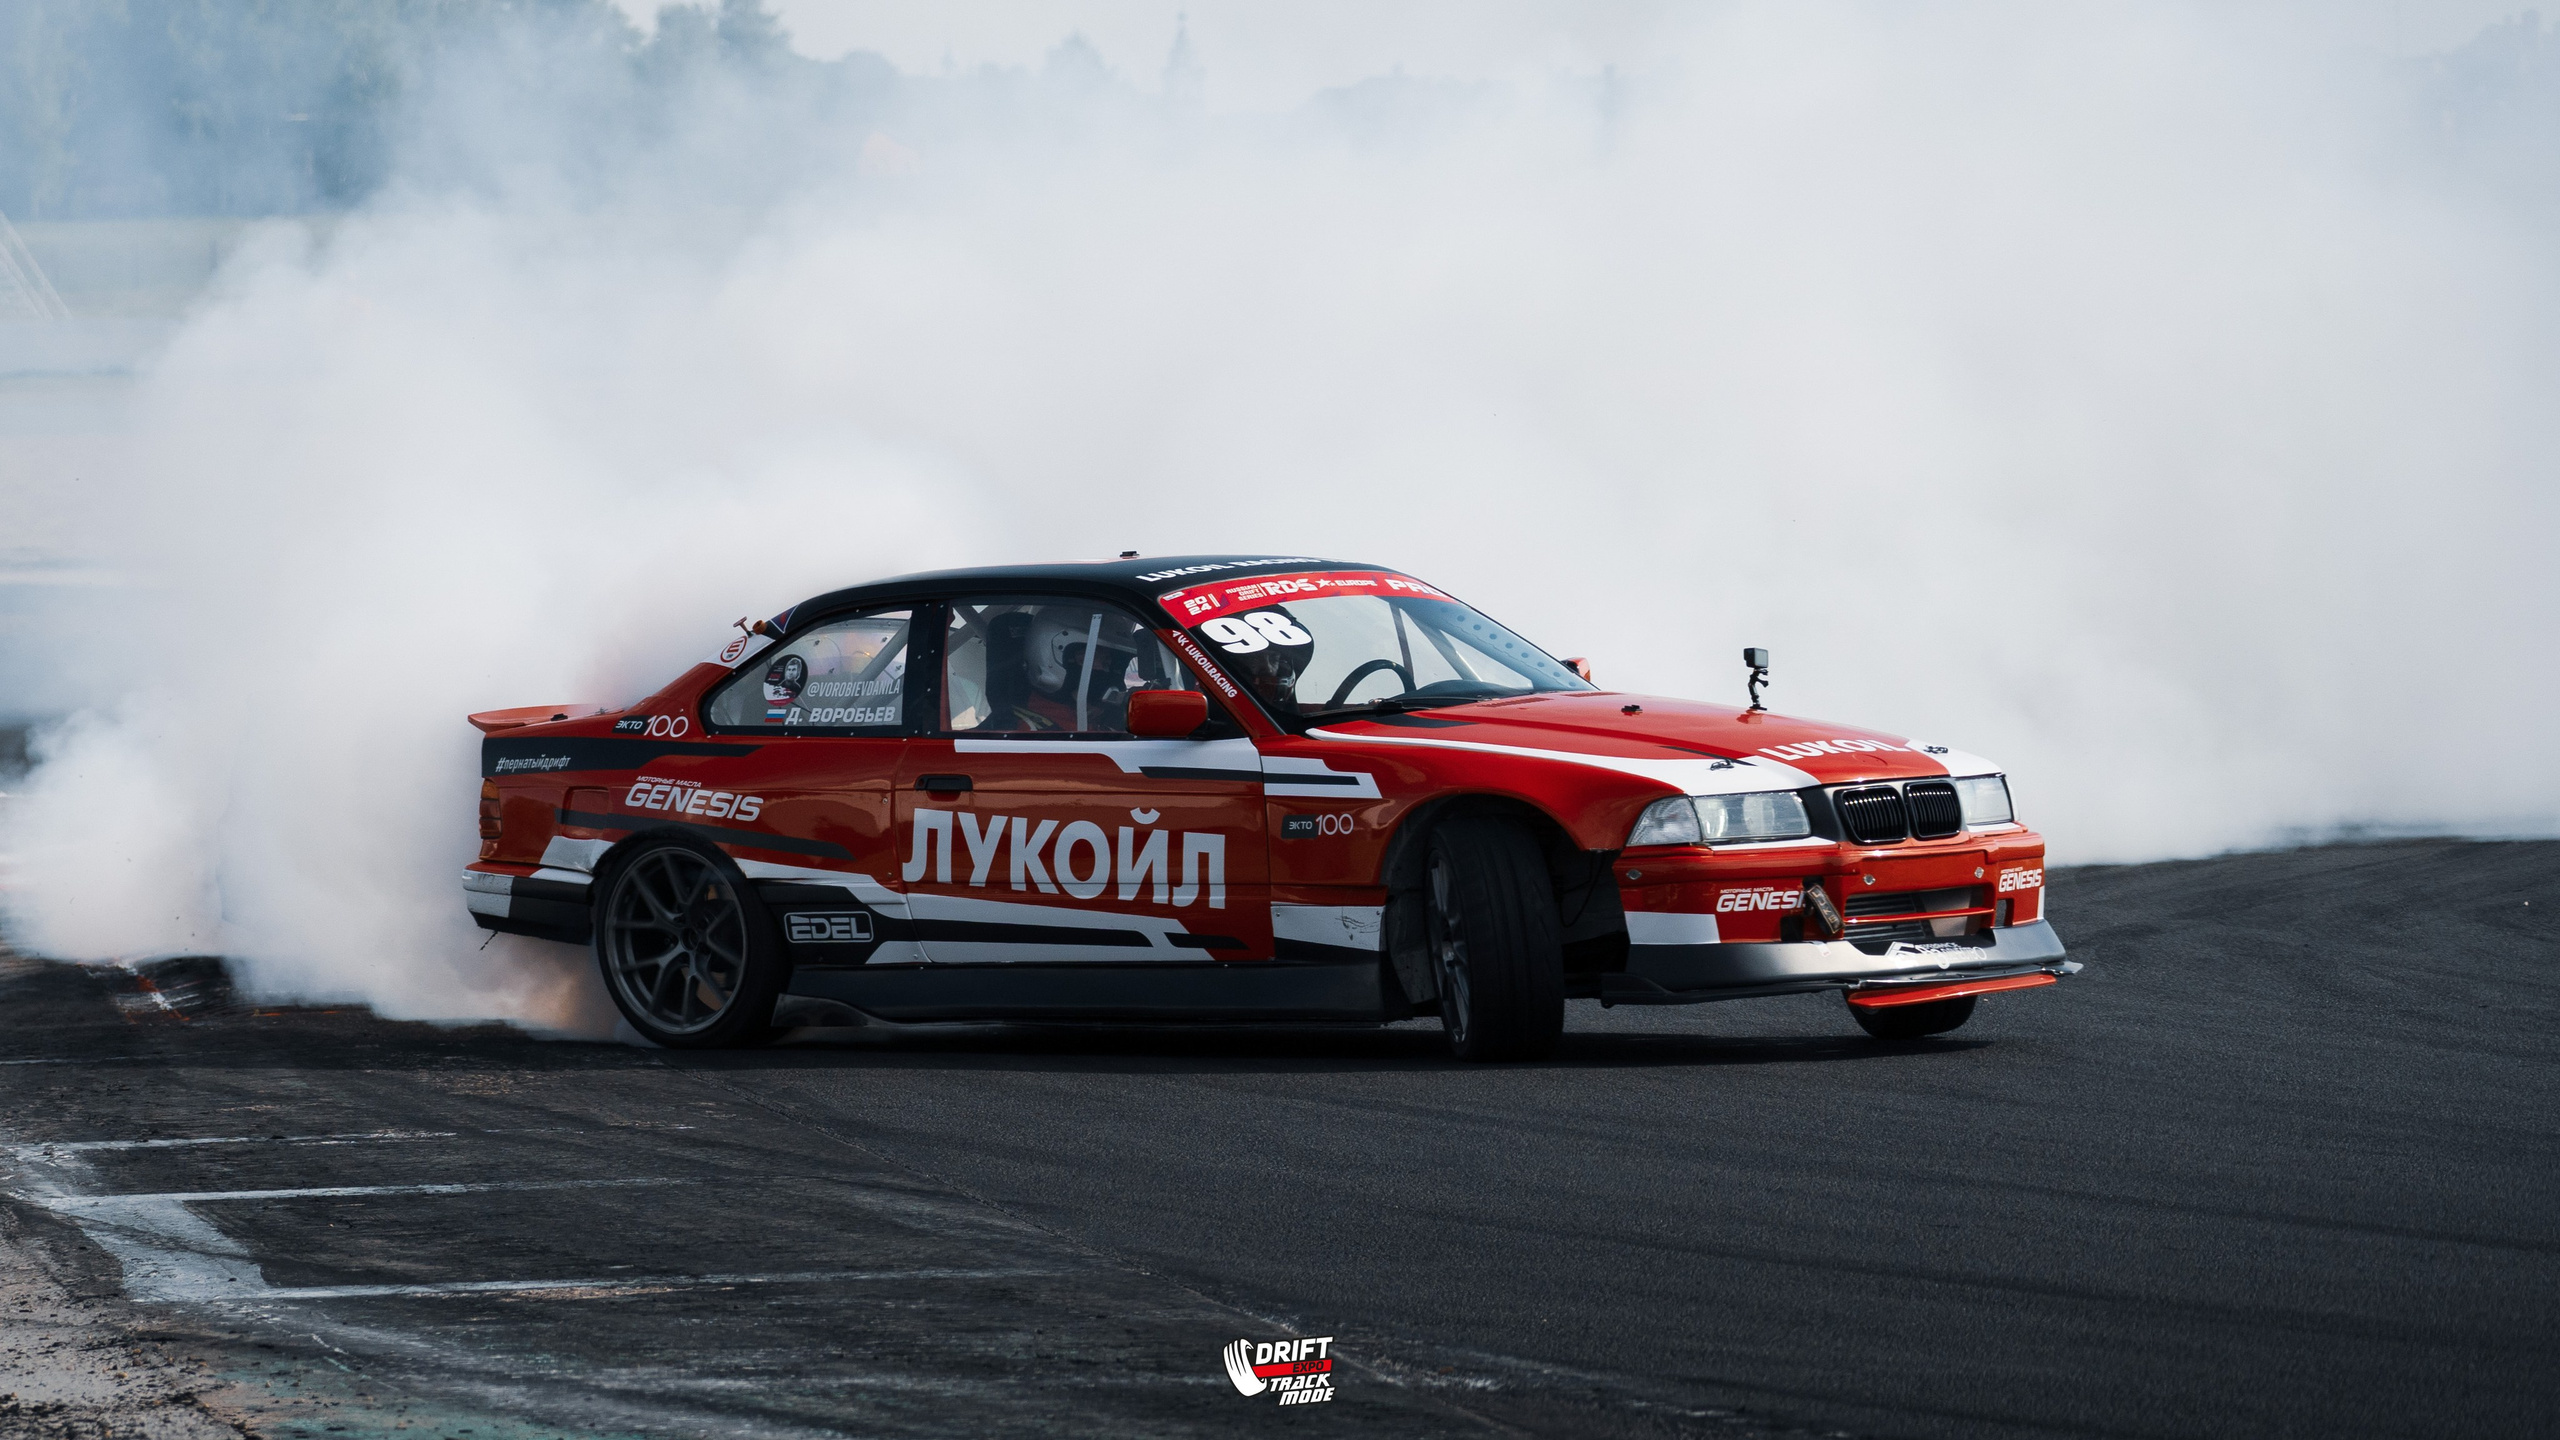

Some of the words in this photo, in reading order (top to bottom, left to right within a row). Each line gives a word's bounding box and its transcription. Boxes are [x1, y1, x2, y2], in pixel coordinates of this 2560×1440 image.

[1135, 564, 1235, 582] LUKOIL
[1225, 584, 1258, 594] RUSSIAN
[1238, 593, 1264, 602] SERIES
[1239, 588, 1260, 596] DRIFT
[1261, 578, 1318, 596] RDS
[1334, 579, 1378, 587] EUROPE
[1201, 611, 1312, 653] 98
[1185, 644, 1238, 698] LUKOILRACING
[807, 679, 901, 697] @VOROBIEVDANILA
[615, 720, 643, 730] ЭКТО
[643, 714, 689, 738] 100
[784, 707, 802, 725] Д.
[809, 706, 896, 723] ВОРОБЬЕВ
[1757, 739, 1912, 761] LUKOIL
[495, 754, 571, 773] #пернатыйдрифт
[636, 775, 676, 786] МОТОРНЫЕ
[676, 779, 702, 788] МАСЛА
[625, 782, 764, 822] GENESIS
[1288, 820, 1313, 830] ЭКТО
[1315, 813, 1354, 836] 100
[902, 807, 1226, 910] ЛУКОЙЛ
[1998, 868, 2043, 892] GENESIS
[1716, 890, 1806, 912] GENESI
[789, 915, 871, 940] EDEL
